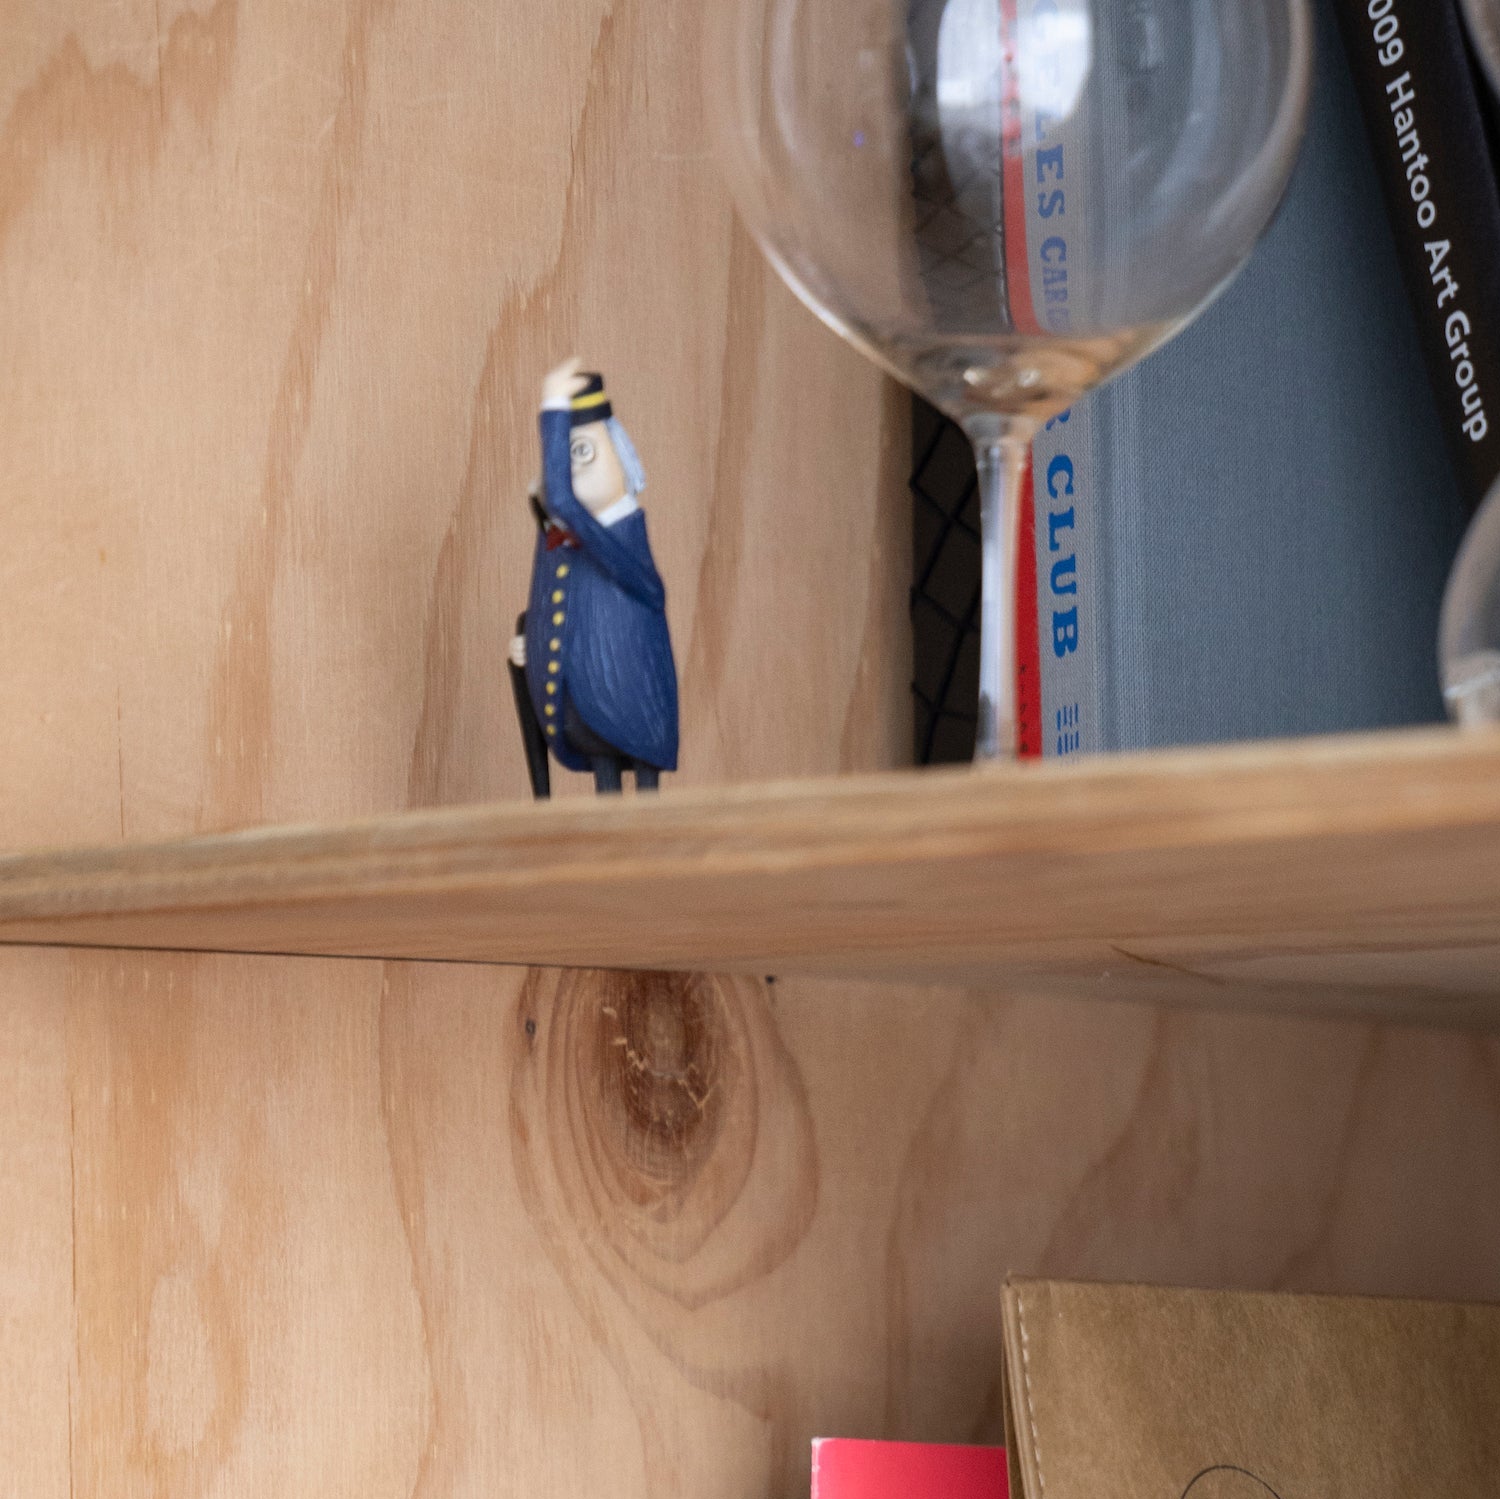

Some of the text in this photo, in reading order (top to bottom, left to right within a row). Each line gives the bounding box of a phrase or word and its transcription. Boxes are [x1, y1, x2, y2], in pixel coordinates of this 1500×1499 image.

[1386, 73, 1438, 229] Hantoo
[1424, 239, 1461, 309] Art
[1444, 312, 1489, 445] Group
[1044, 455, 1080, 660] CLUB
